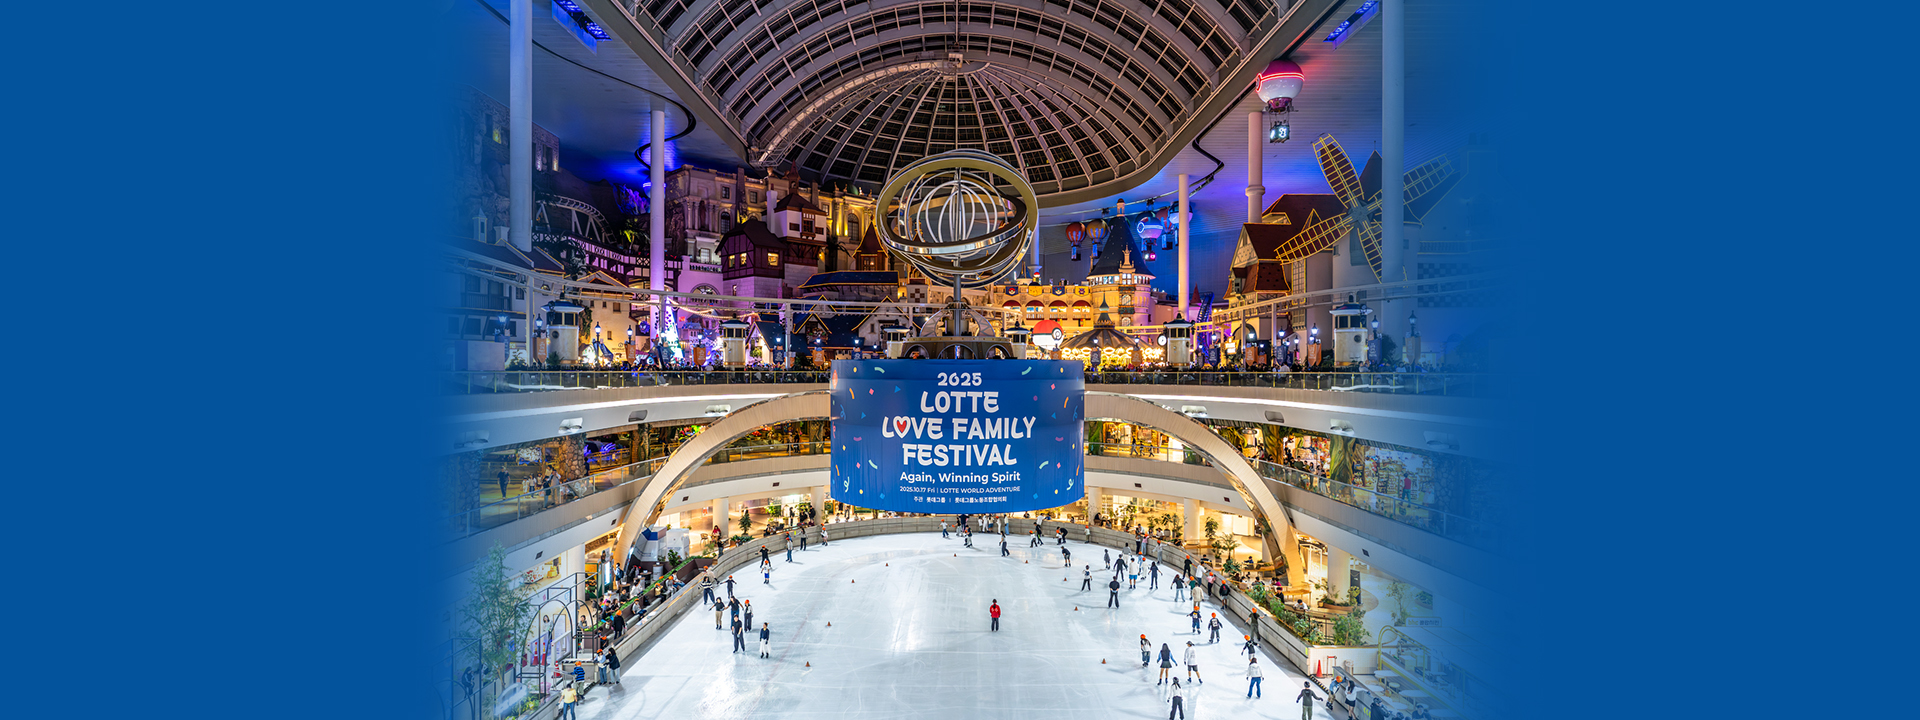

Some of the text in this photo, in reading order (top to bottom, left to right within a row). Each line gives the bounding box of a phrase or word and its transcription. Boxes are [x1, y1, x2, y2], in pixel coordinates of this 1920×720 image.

[937, 372, 982, 386] 2025
[920, 391, 999, 413] LOTTE
[952, 416, 1036, 440] FAMILY
[902, 443, 1017, 466] FESTIVAL
[900, 471, 1021, 484] Again, Winning Spirit
